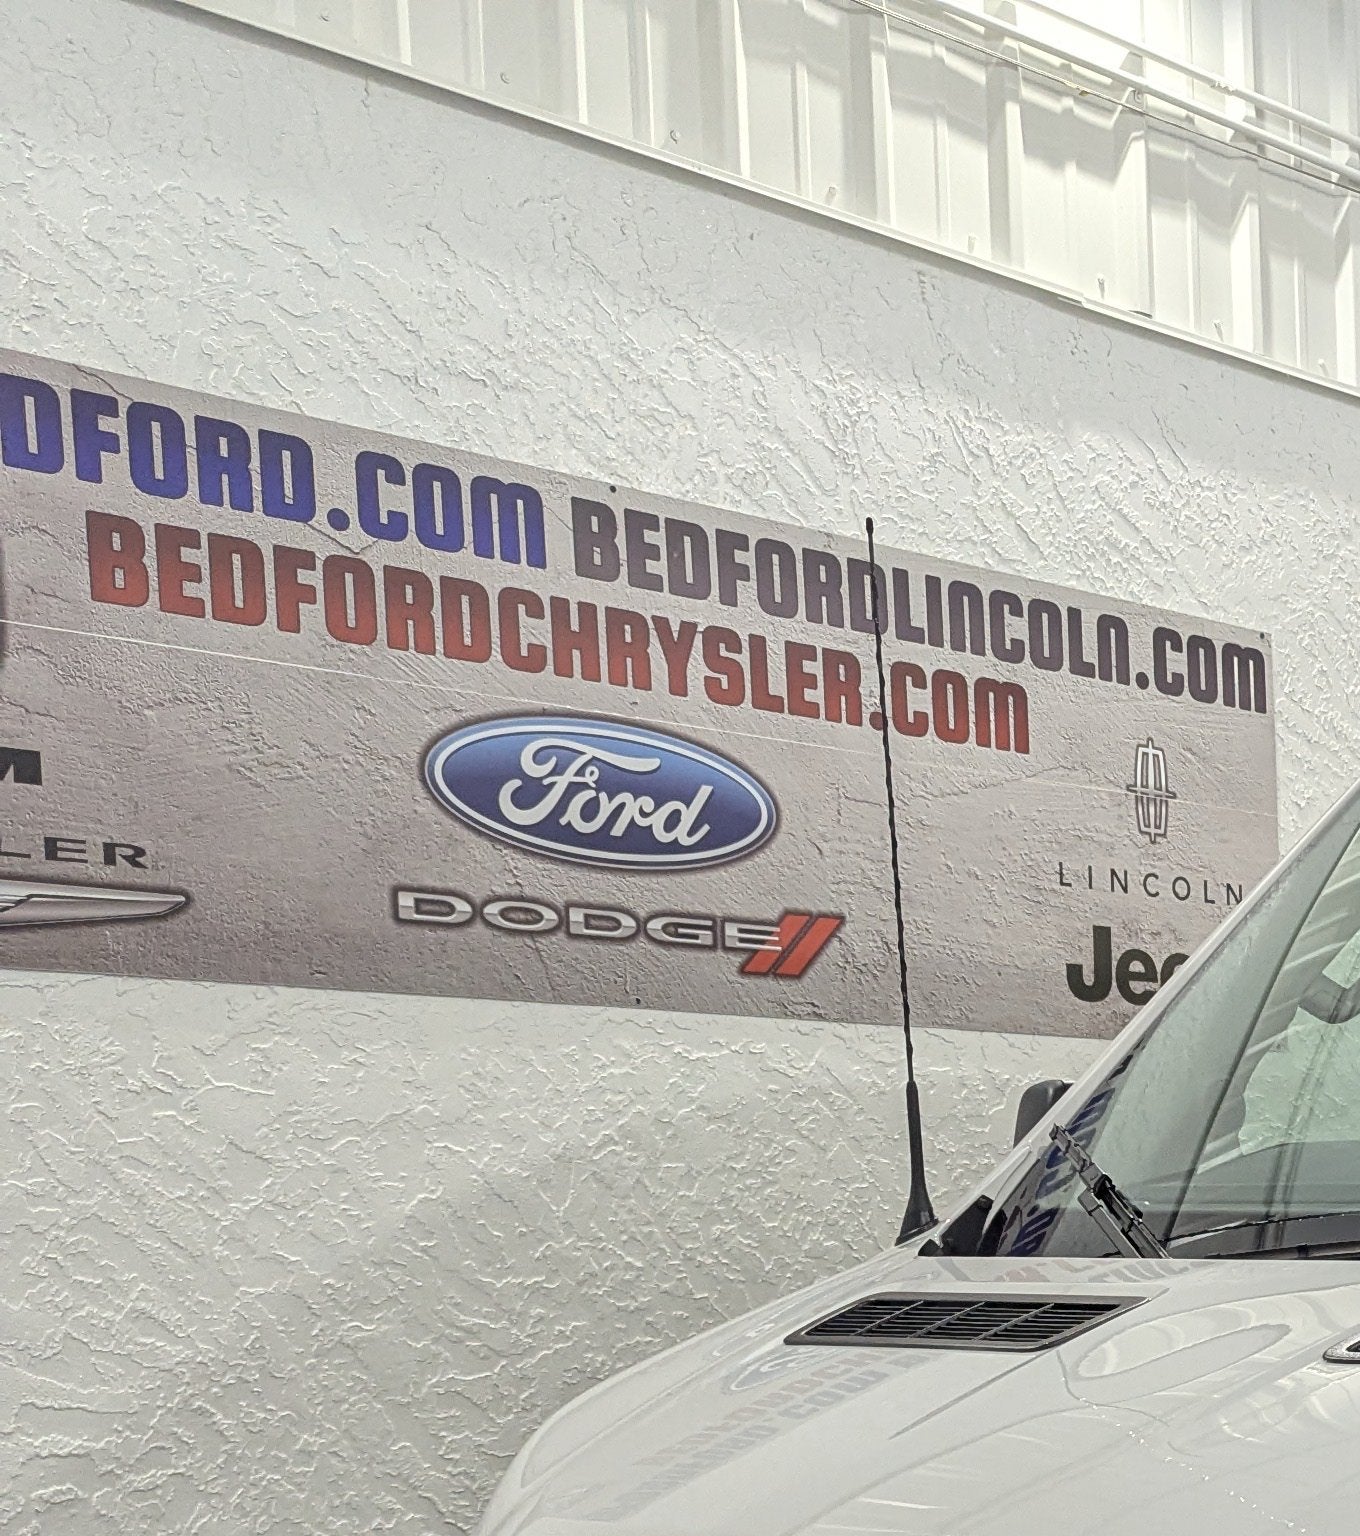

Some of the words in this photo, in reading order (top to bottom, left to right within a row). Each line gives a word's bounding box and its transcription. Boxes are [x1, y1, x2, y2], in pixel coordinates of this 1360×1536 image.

[85, 509, 1030, 755] BEDFORDCHRYSLER.COM
[572, 496, 1267, 714] BEDFORDLINCOLN.COM
[498, 737, 715, 846] Ford
[398, 891, 783, 952] DODGE
[1058, 861, 1243, 906] LINCOLN
